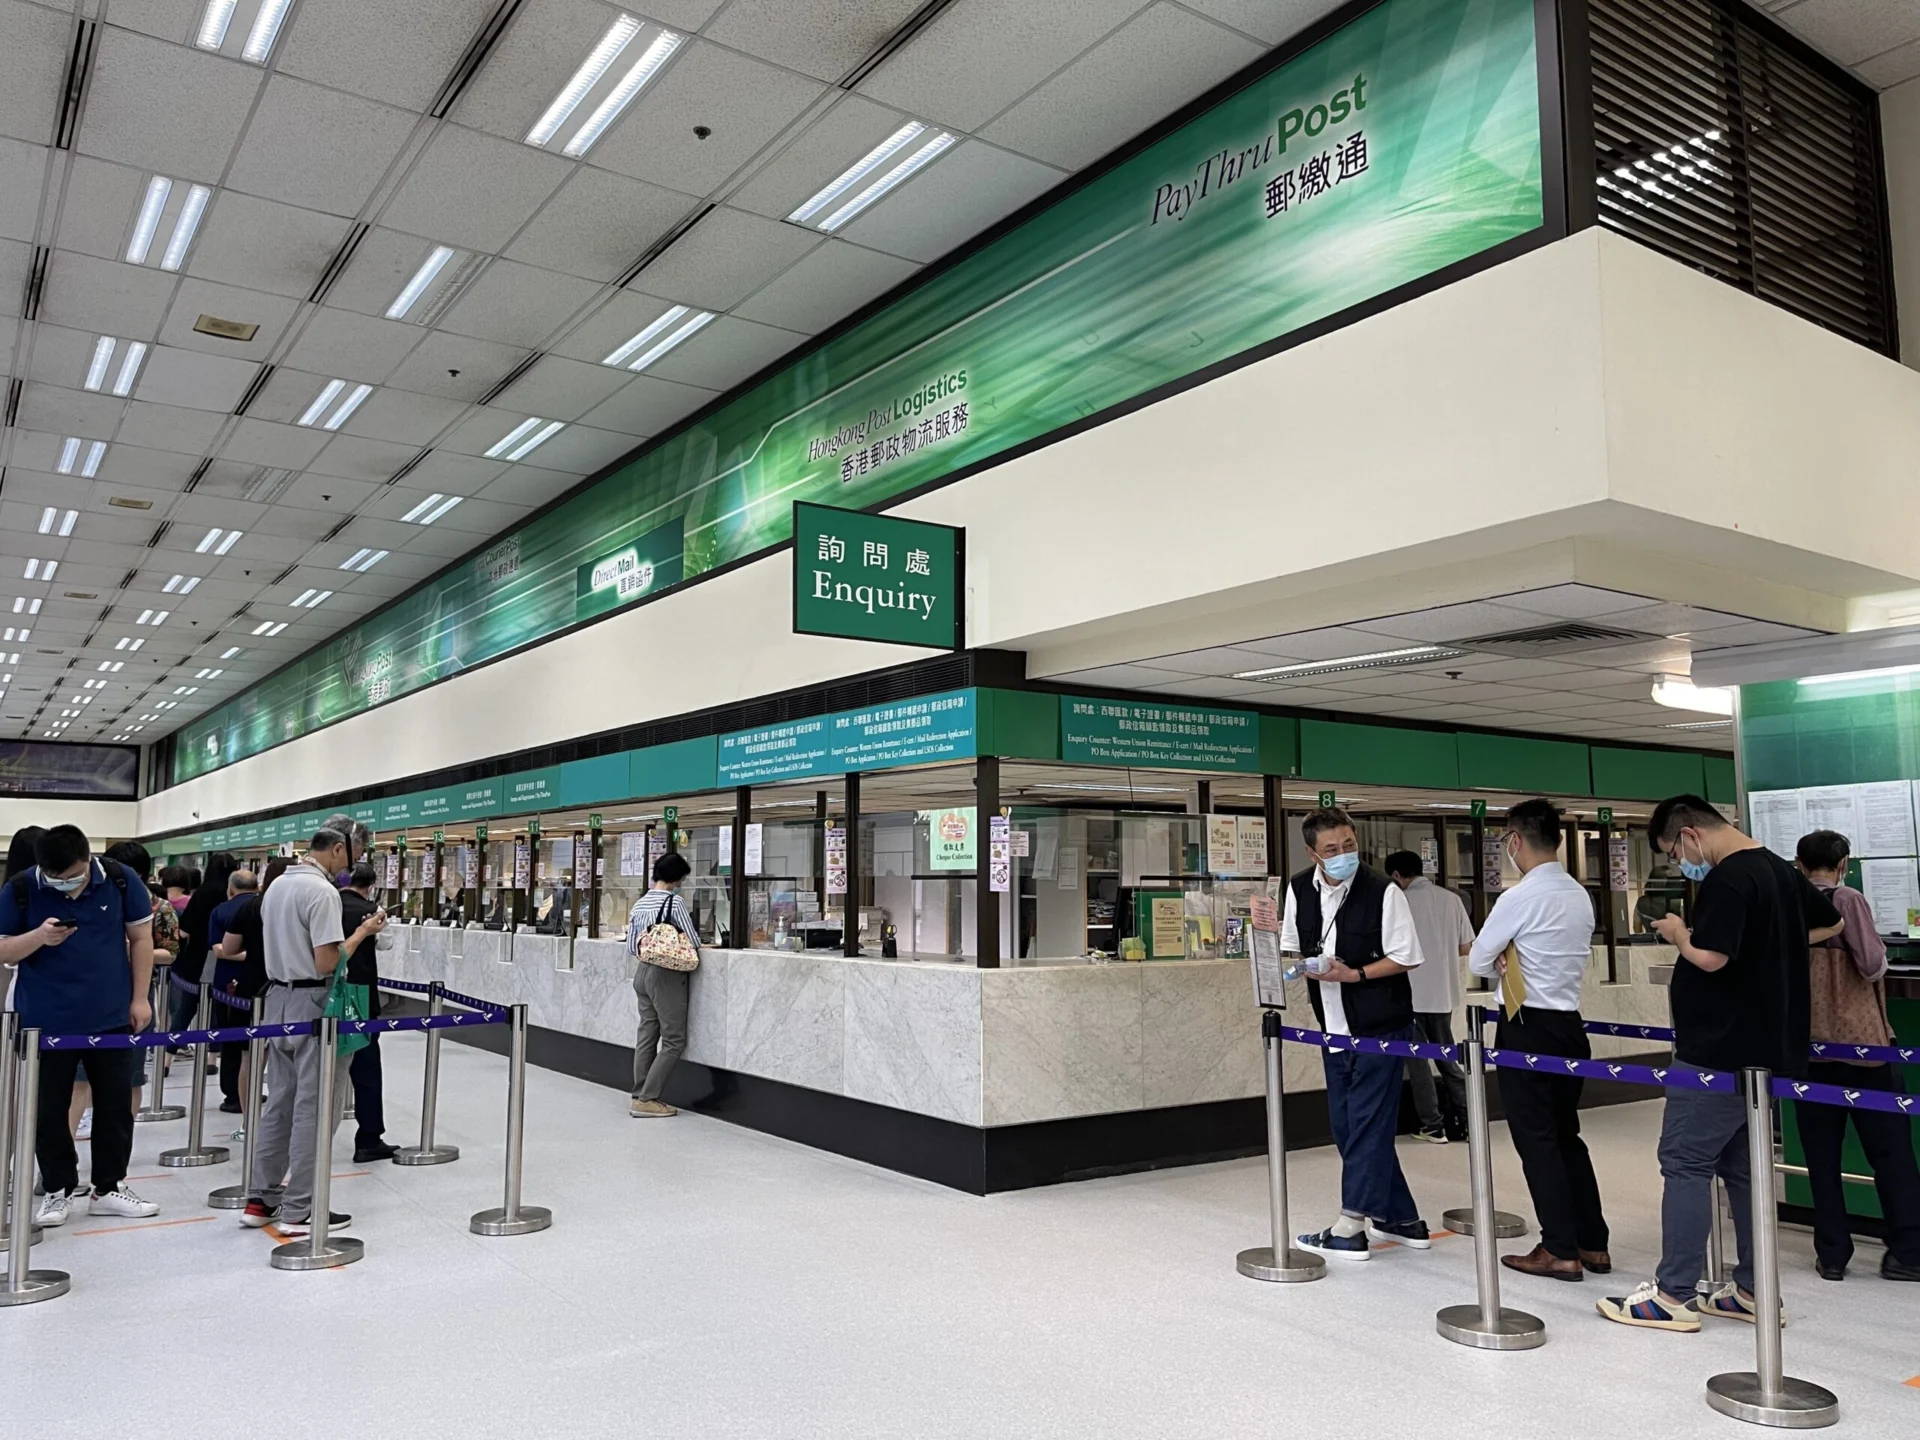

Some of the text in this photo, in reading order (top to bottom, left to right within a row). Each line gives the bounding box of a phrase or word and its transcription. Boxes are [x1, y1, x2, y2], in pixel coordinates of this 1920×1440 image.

[1265, 130, 1370, 219] 郵繳通
[807, 369, 968, 463] Hongkong Post Logistics
[841, 401, 969, 483] 香港郵政物流服務
[818, 534, 931, 576] 詢問處
[812, 570, 936, 620] Enquiry
[1322, 793, 1332, 808] 8
[666, 808, 675, 820] 9
[1474, 801, 1483, 815] 7
[590, 815, 601, 827] 10
[1600, 809, 1610, 822] 6
[477, 827, 486, 837] 12
[530, 822, 539, 832] 11
[397, 836, 406, 845] 14
[434, 832, 443, 841] 13
